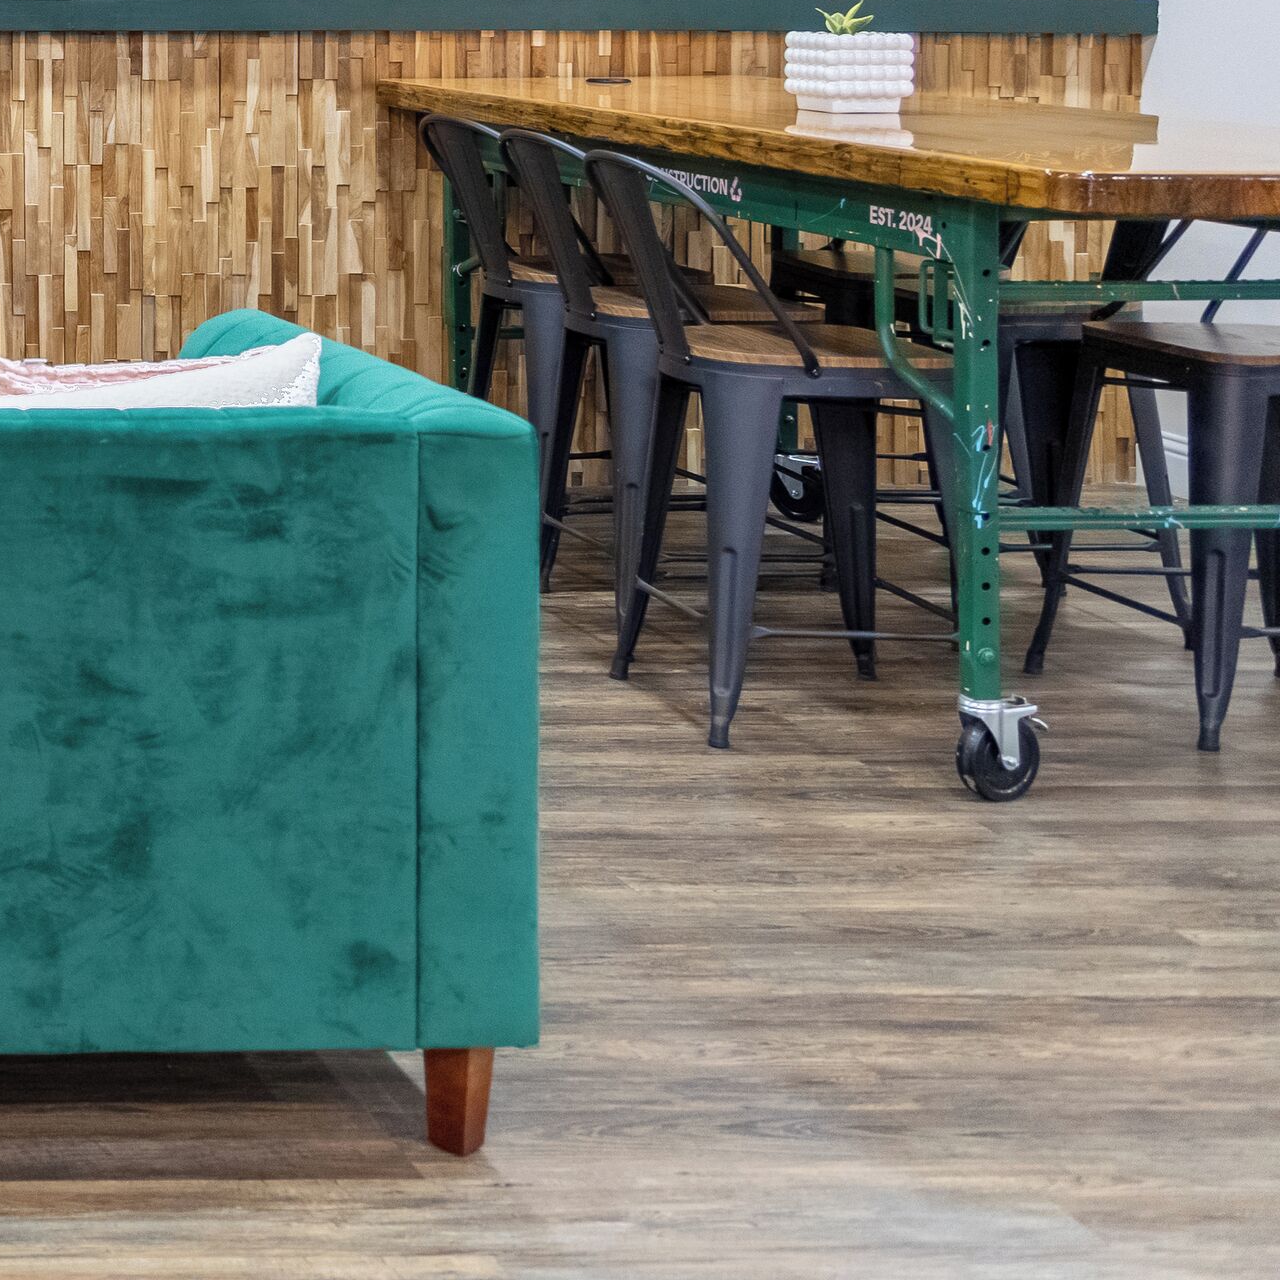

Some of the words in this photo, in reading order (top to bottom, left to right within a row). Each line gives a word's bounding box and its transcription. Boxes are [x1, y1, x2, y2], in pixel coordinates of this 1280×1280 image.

[645, 166, 728, 195] TRUCTION
[869, 205, 897, 228] EST.
[898, 210, 933, 236] 2024
